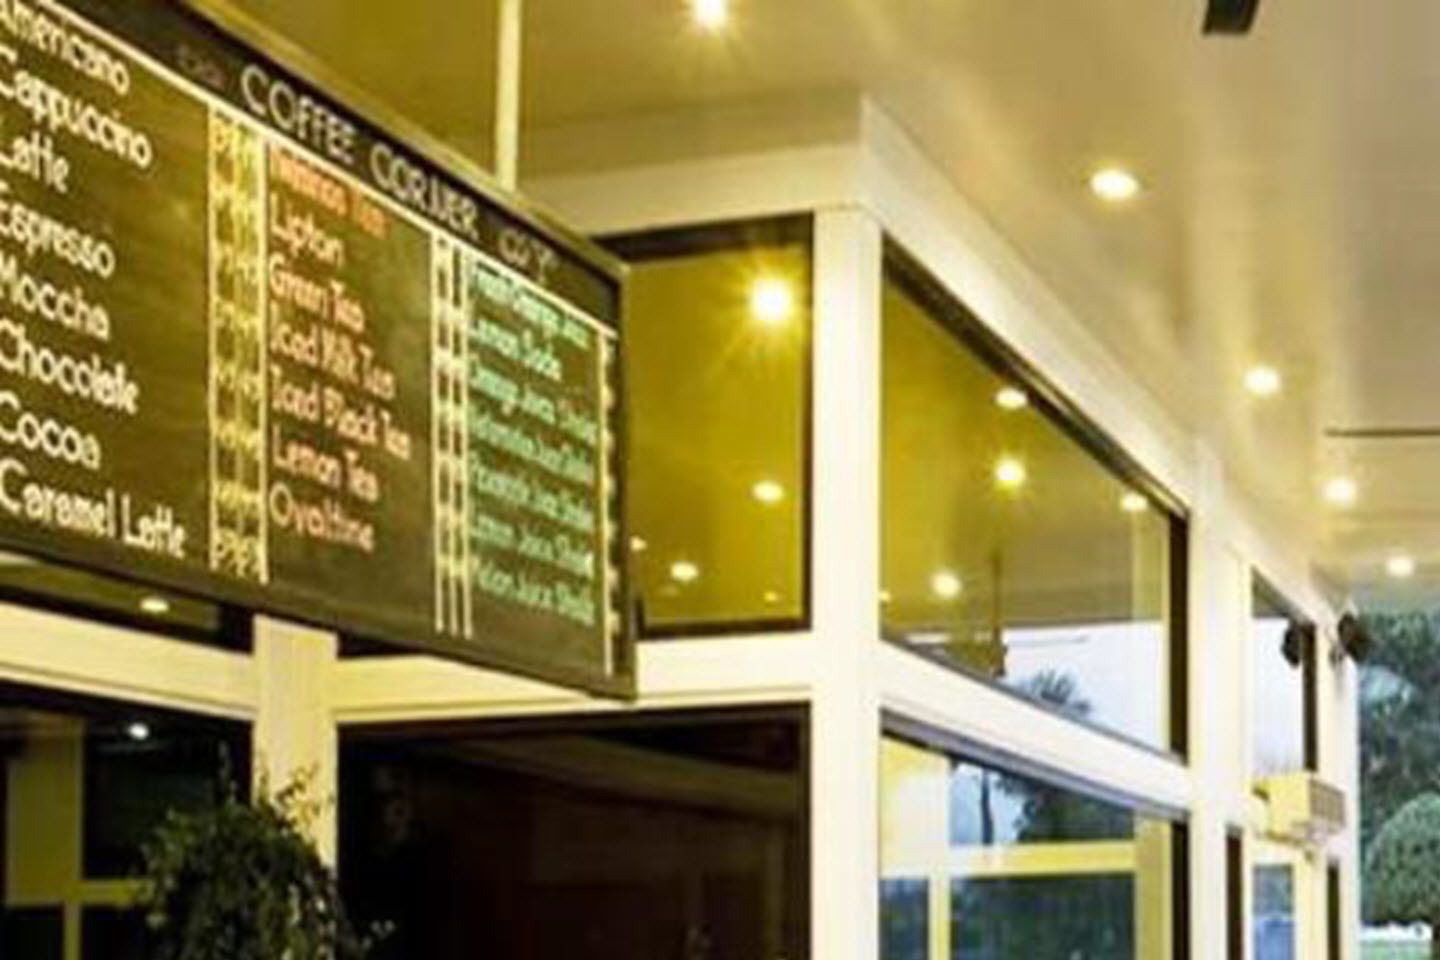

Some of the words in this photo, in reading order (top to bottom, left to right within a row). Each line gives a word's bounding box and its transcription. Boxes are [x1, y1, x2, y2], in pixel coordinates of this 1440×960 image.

[241, 64, 355, 164] COFFEE
[369, 143, 480, 241] CORNER
[269, 192, 345, 270] Lipton
[269, 253, 329, 319] Green
[330, 278, 364, 334] Tea
[269, 300, 320, 367] Iced
[359, 344, 396, 401] Tea
[0, 390, 100, 470] Cocoa
[269, 363, 320, 424] Iced
[380, 409, 411, 461] Tea
[272, 422, 341, 490] Lemon
[345, 449, 380, 503] Tea
[0, 457, 115, 538] Caramel
[121, 492, 186, 560] Latte
